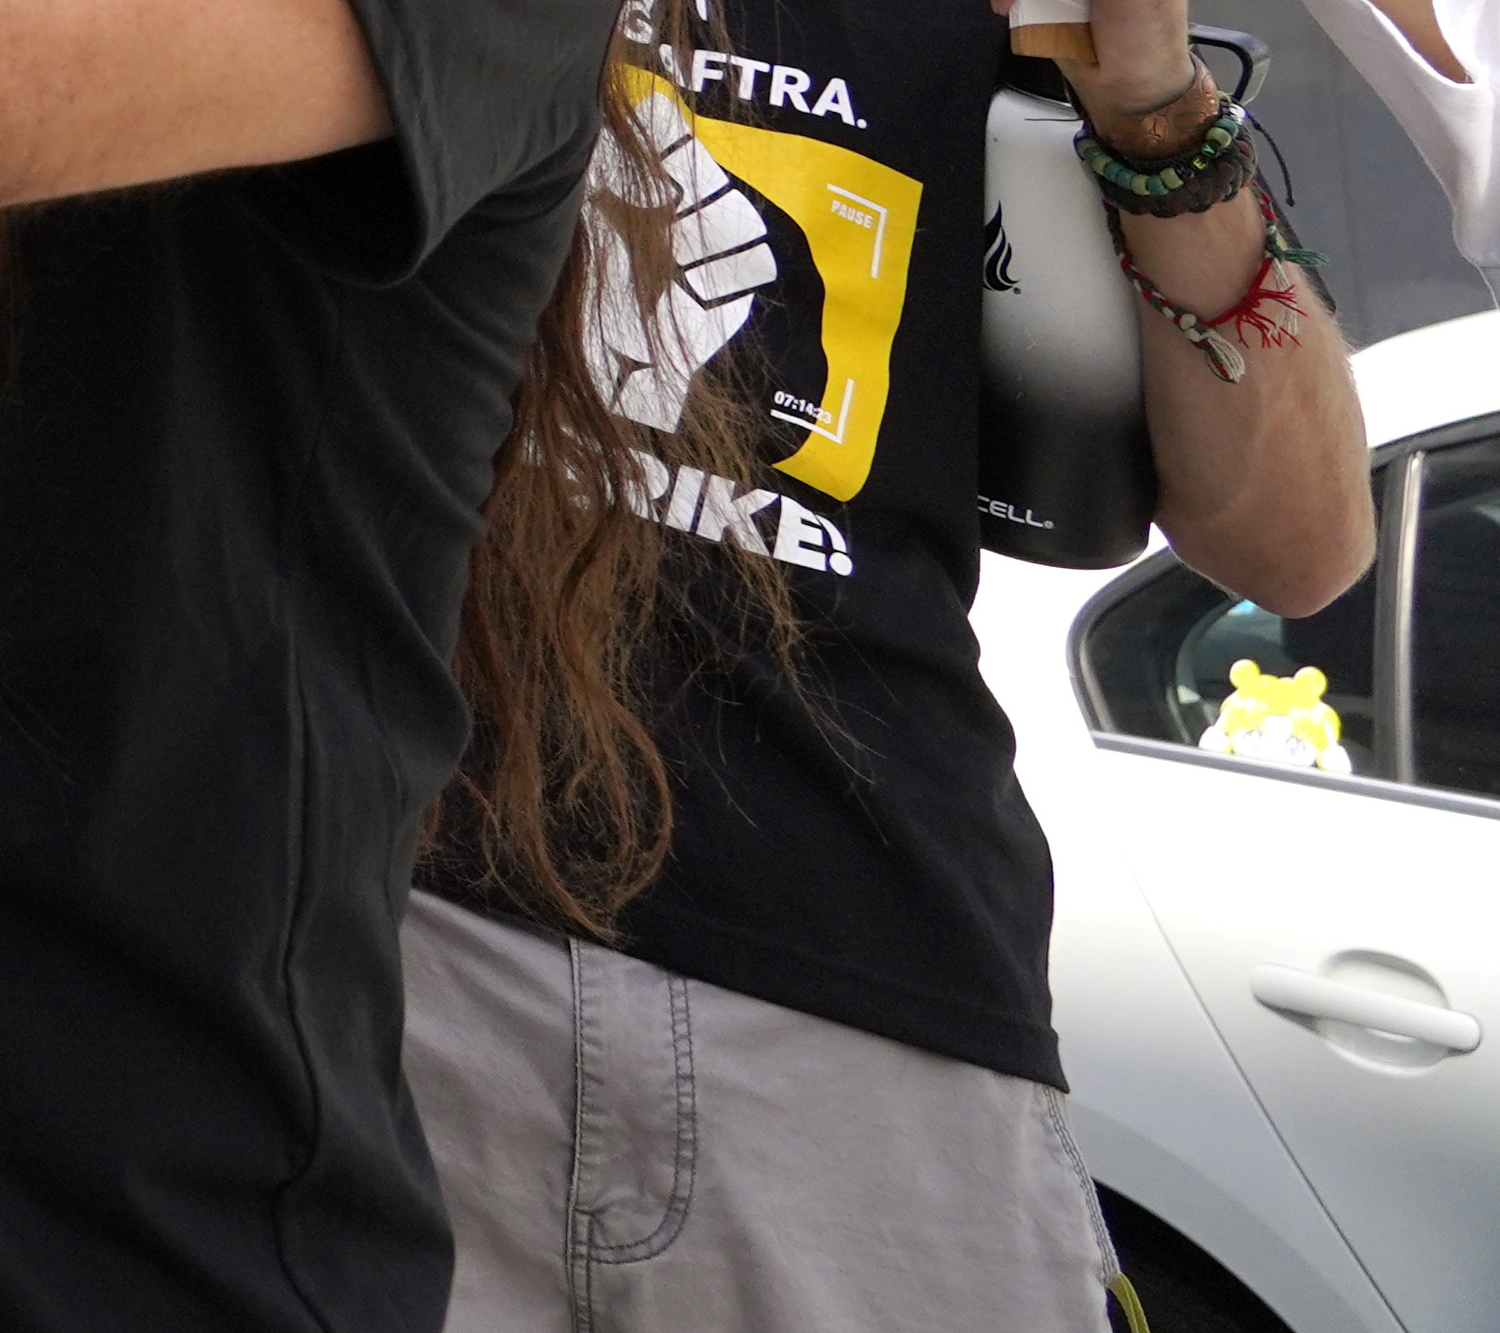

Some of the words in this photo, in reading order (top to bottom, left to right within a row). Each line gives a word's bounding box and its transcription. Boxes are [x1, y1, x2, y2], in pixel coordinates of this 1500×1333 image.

[831, 199, 875, 230] PAUSE
[773, 390, 833, 425] 07:14:23
[618, 445, 854, 577] RIKE!
